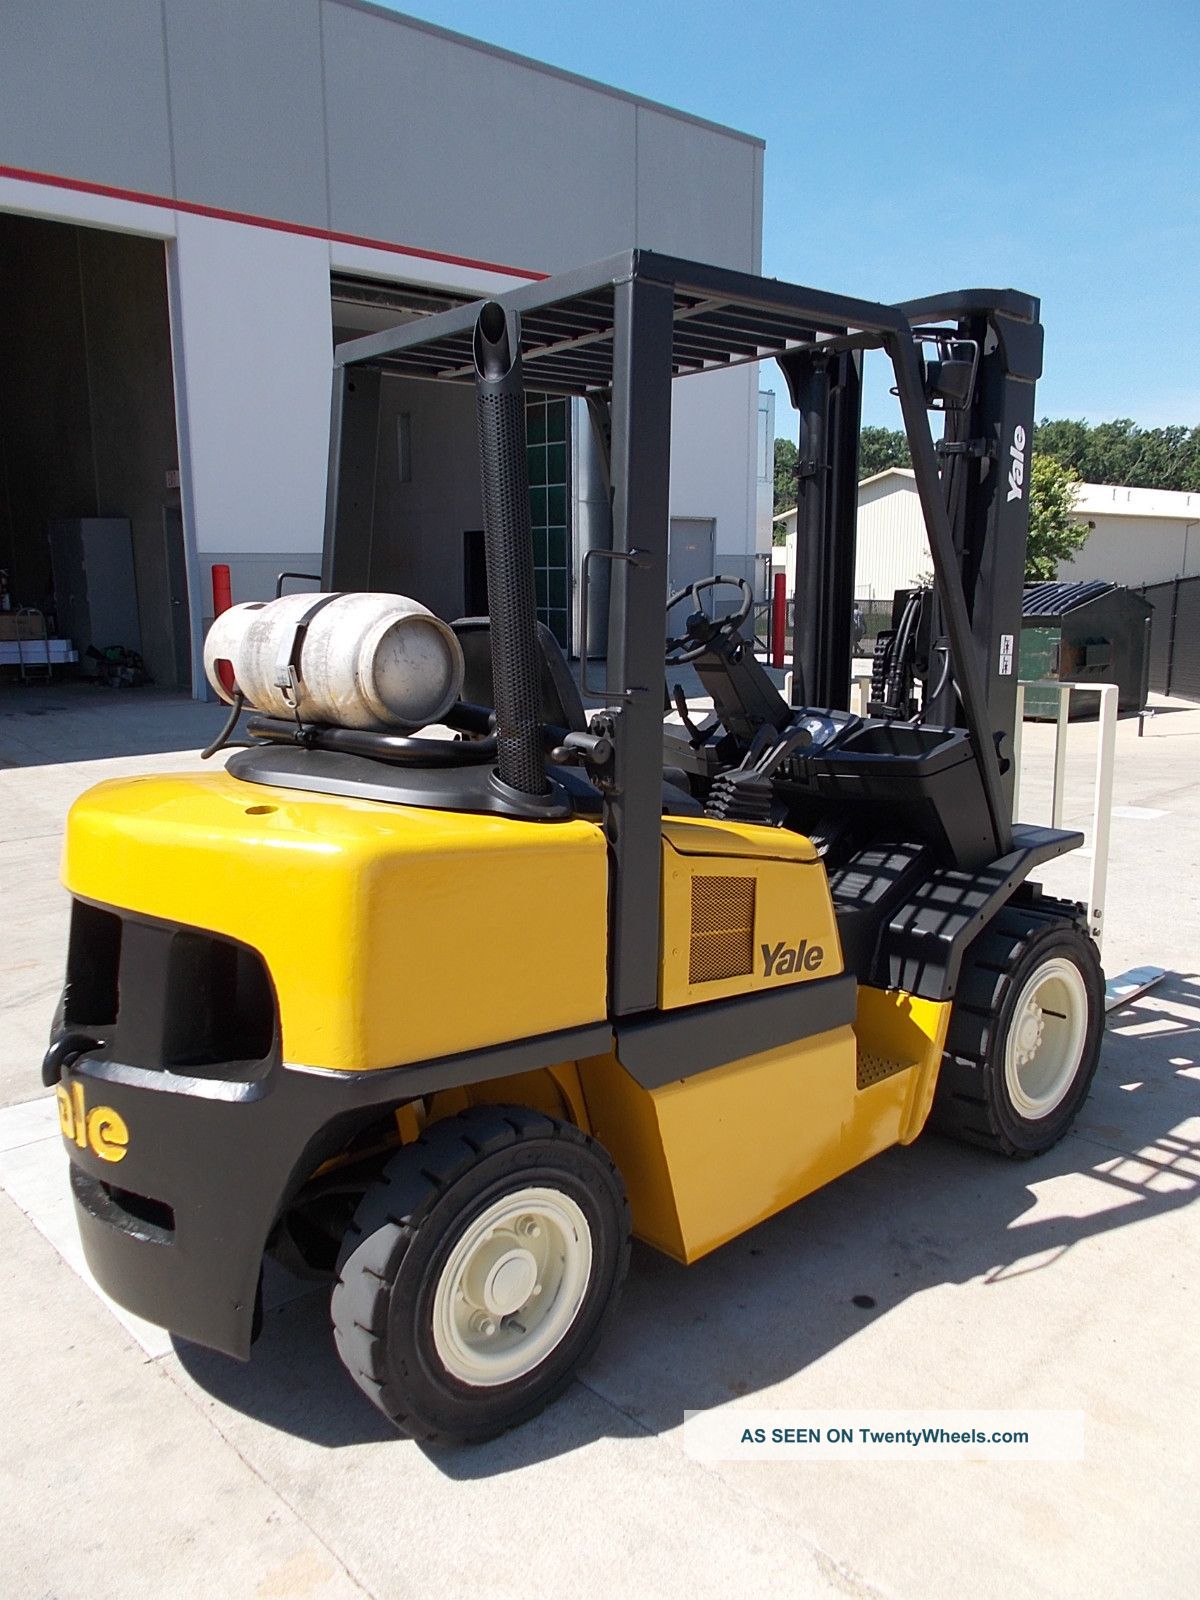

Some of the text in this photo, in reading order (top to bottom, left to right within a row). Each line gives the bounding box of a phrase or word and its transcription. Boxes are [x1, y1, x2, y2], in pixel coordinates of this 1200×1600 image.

[1007, 425, 1026, 502] Yale
[761, 939, 824, 977] Yale
[57, 1080, 129, 1163] ale
